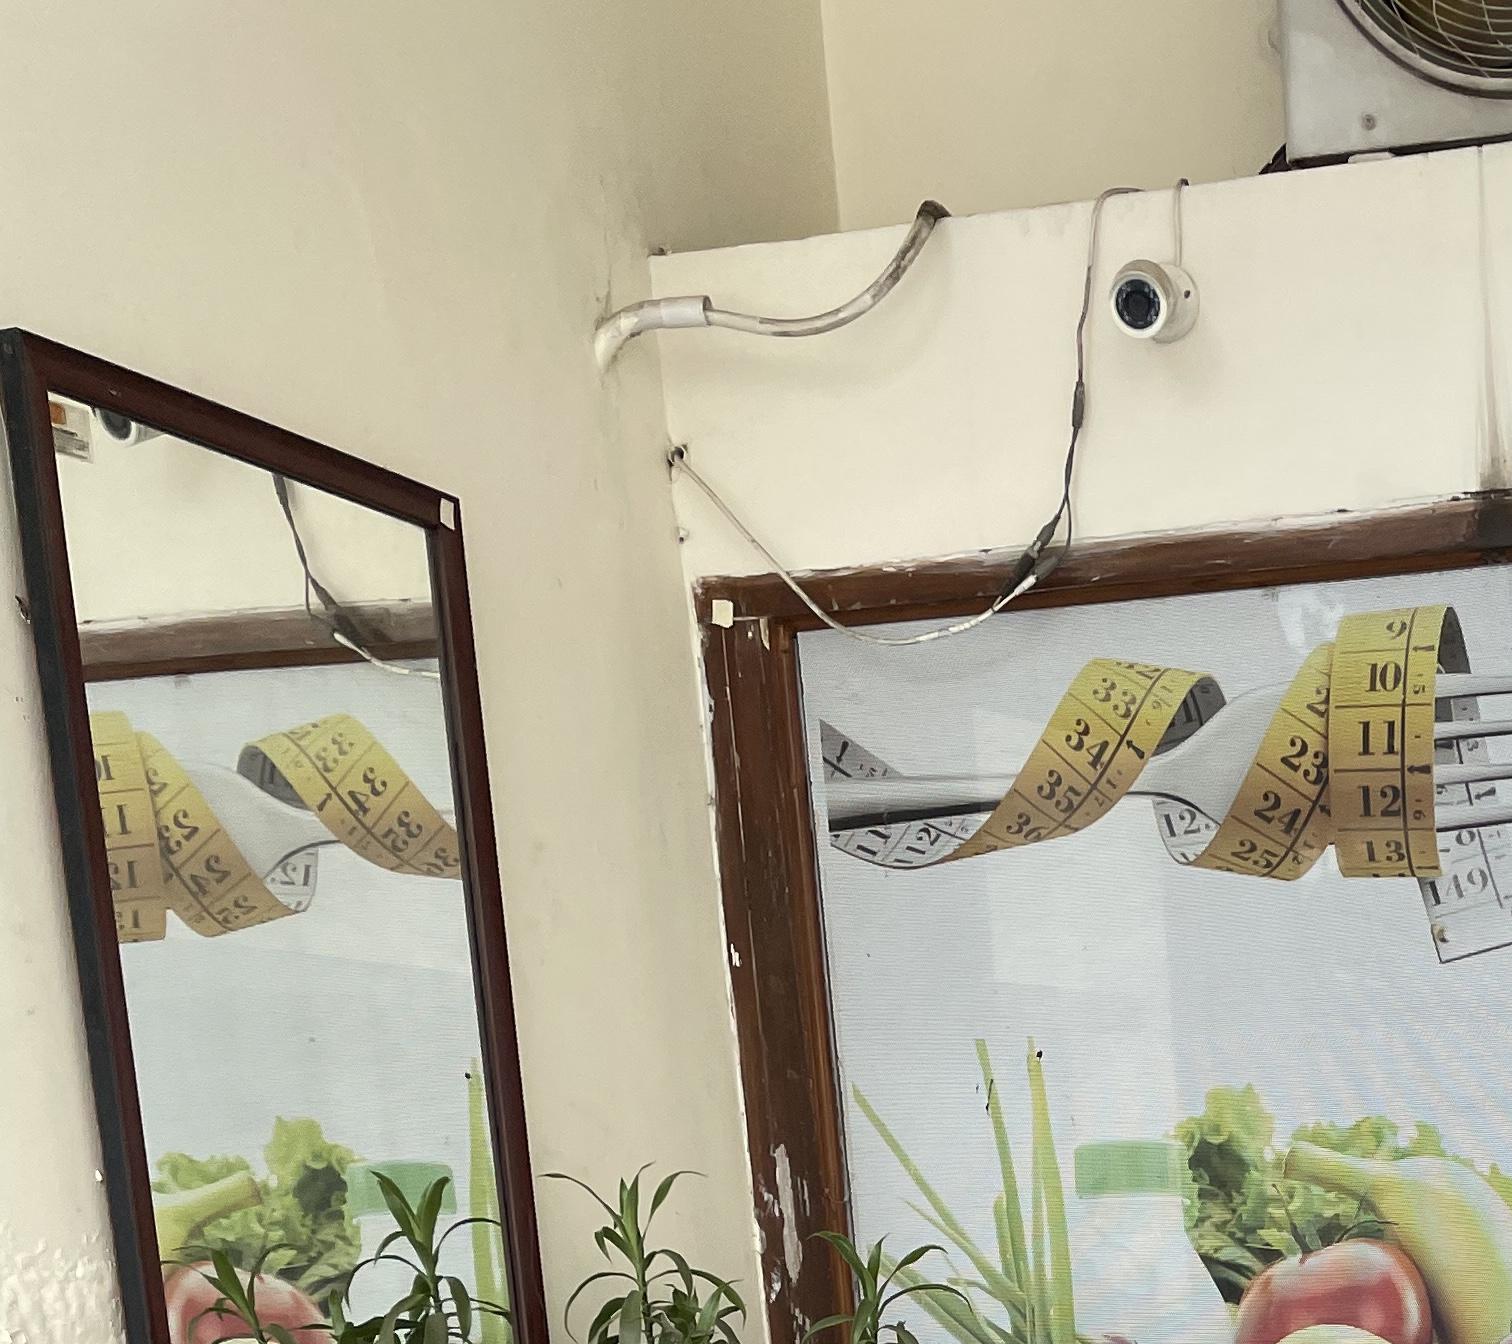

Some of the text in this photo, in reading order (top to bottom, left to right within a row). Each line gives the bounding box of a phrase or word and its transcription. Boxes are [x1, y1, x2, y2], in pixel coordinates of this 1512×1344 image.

[1364, 661, 1402, 693] 10
[1092, 677, 1137, 719] 33
[1064, 717, 1111, 772] 34
[1357, 719, 1400, 757] 11
[1280, 734, 1330, 785] 23
[1036, 769, 1084, 814] 35
[1358, 784, 1402, 819] 12
[1005, 811, 1050, 843] 36
[1253, 790, 1302, 837] 24
[1230, 839, 1280, 870] 25
[1364, 840, 1406, 864] 13
